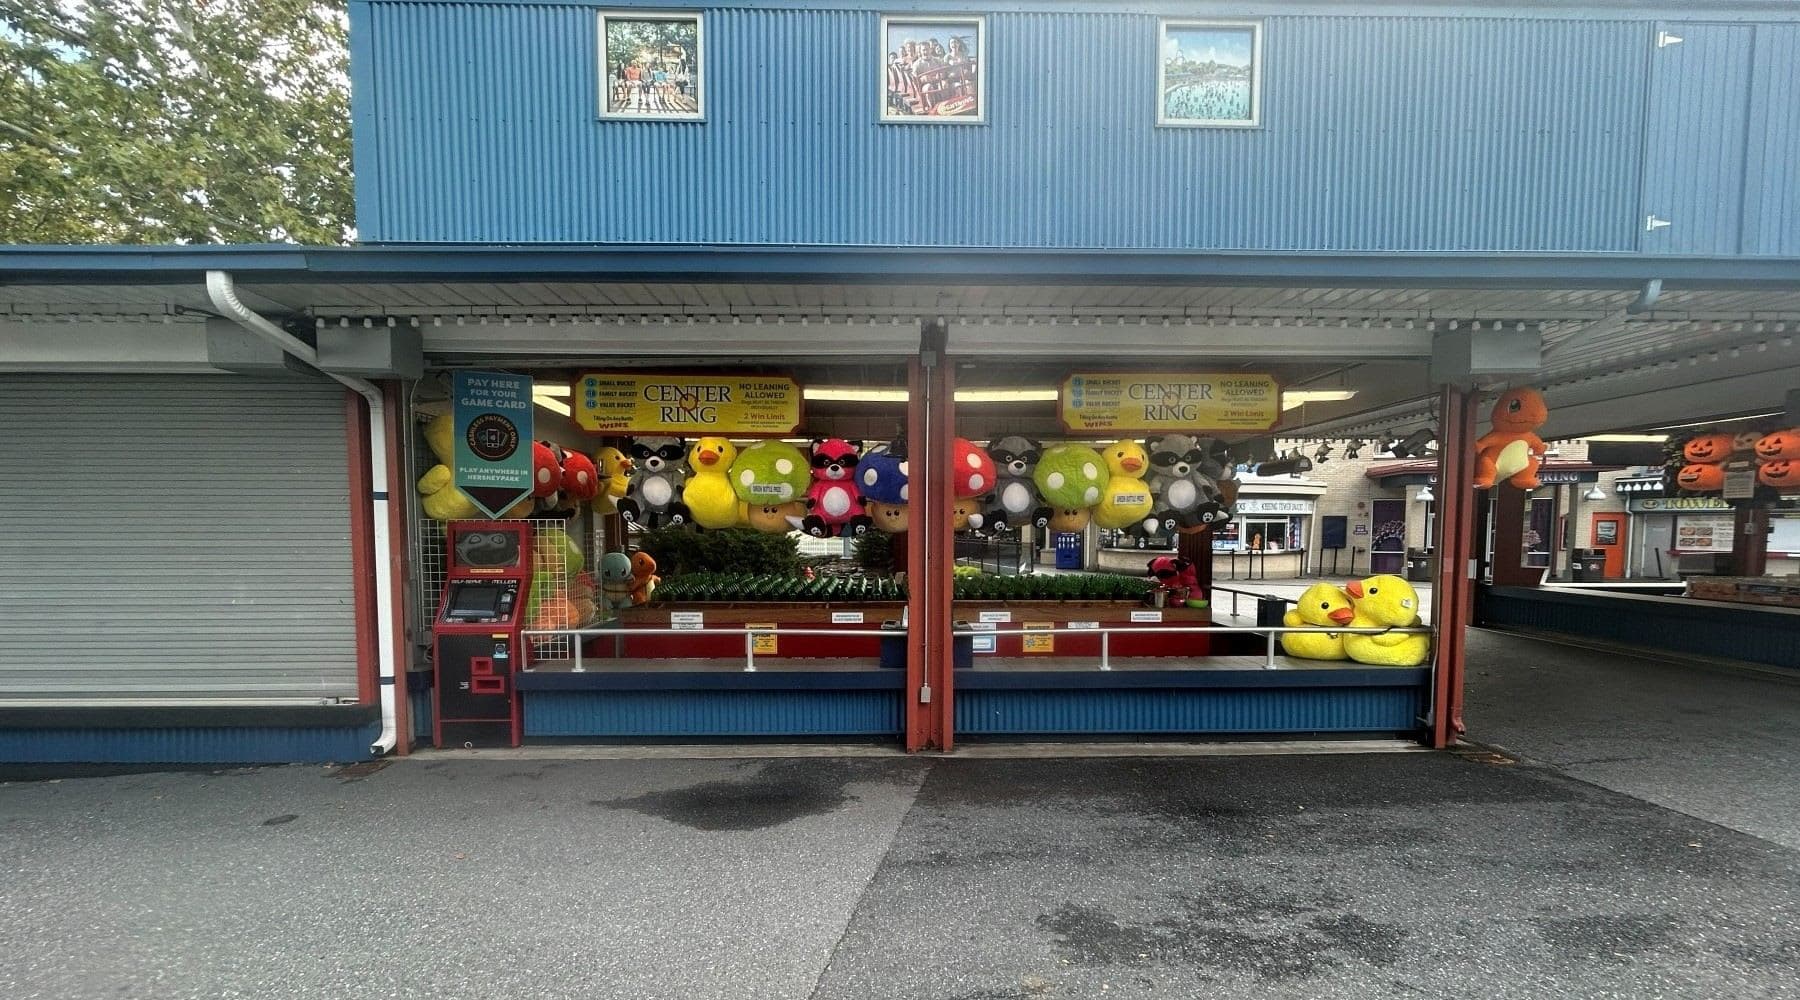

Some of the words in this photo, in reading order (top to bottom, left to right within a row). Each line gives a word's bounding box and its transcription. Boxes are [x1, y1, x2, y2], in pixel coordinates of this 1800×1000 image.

[468, 378, 488, 387] PAY
[491, 380, 520, 389] HERE
[492, 390, 516, 398] YOUR
[644, 384, 731, 402] CENTER
[1128, 384, 1212, 400] CENTER
[461, 398, 494, 407] GAME
[496, 400, 526, 409] CARD
[660, 406, 716, 423] RING
[1144, 404, 1197, 420] RING
[485, 416, 514, 430] PAYMENT
